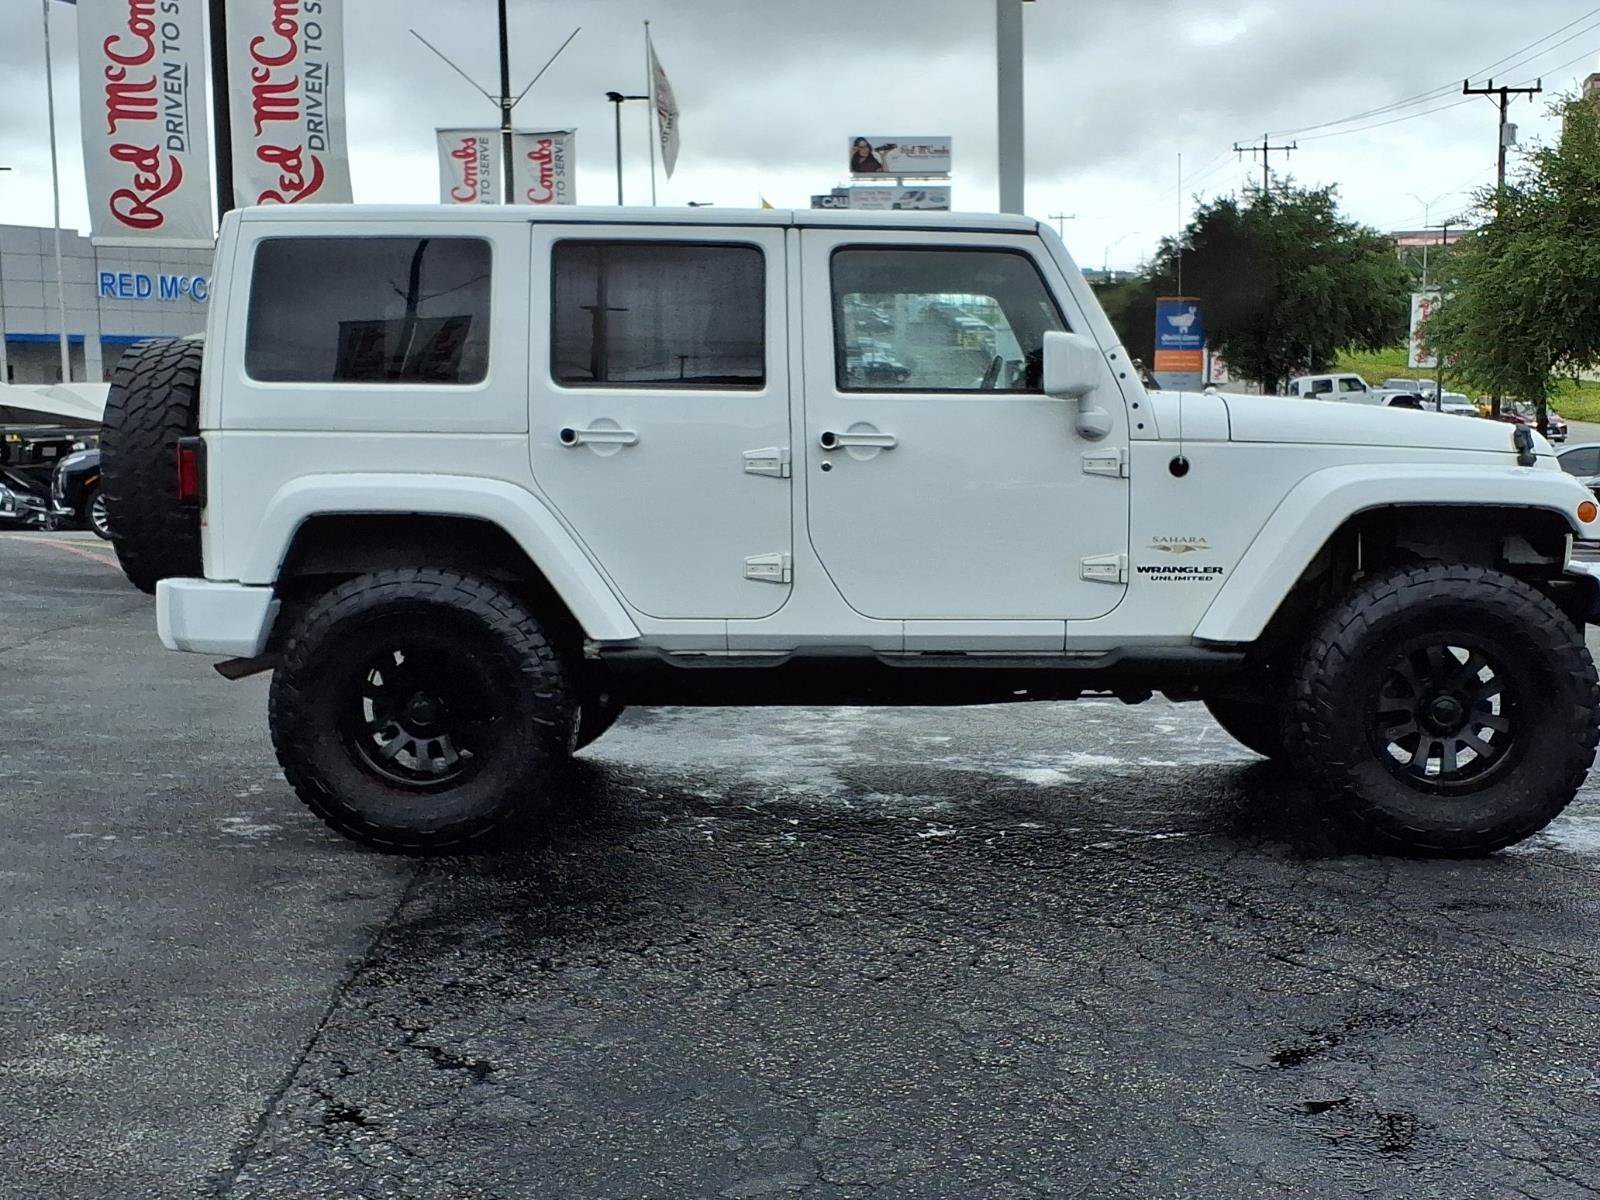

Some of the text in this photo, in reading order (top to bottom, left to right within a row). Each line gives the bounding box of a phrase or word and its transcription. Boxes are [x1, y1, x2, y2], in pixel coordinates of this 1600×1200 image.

[160, 0, 186, 152] DRIVEN TO S
[303, 0, 326, 151] DRIVEN TO S
[479, 137, 490, 177] SERVE
[554, 138, 566, 177] SERVE
[109, 143, 183, 229] Red
[480, 179, 491, 196] TO
[556, 180, 566, 197] TO
[100, 272, 211, 302] RED McC
[1152, 536, 1207, 544] SAHARA
[1136, 566, 1224, 575] WRANGLER
